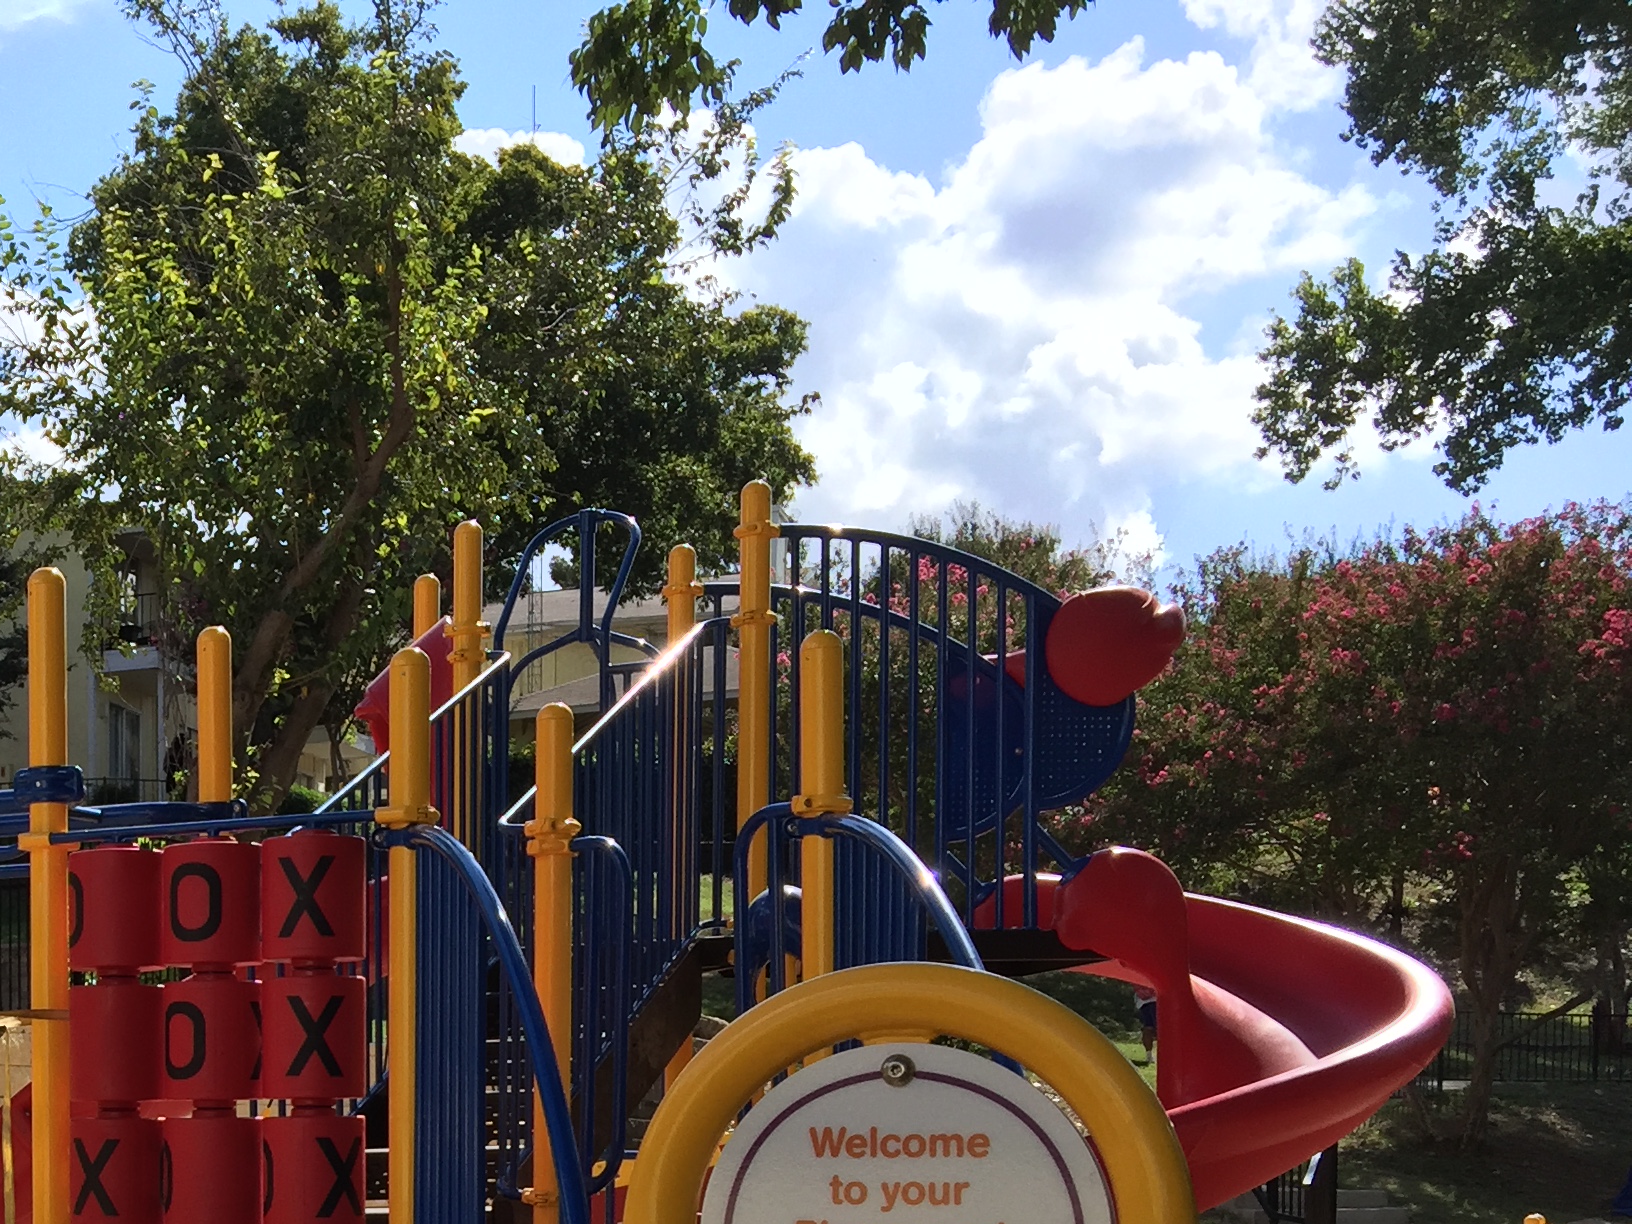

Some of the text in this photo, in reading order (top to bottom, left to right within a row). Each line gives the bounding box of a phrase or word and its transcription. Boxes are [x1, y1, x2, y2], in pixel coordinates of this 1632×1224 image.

[278, 855, 335, 938] X
[286, 996, 345, 1078] X
[73, 1138, 120, 1217] X
[316, 1137, 363, 1217] X
[809, 1126, 990, 1158] Welcome
[829, 1175, 970, 1212] to your
